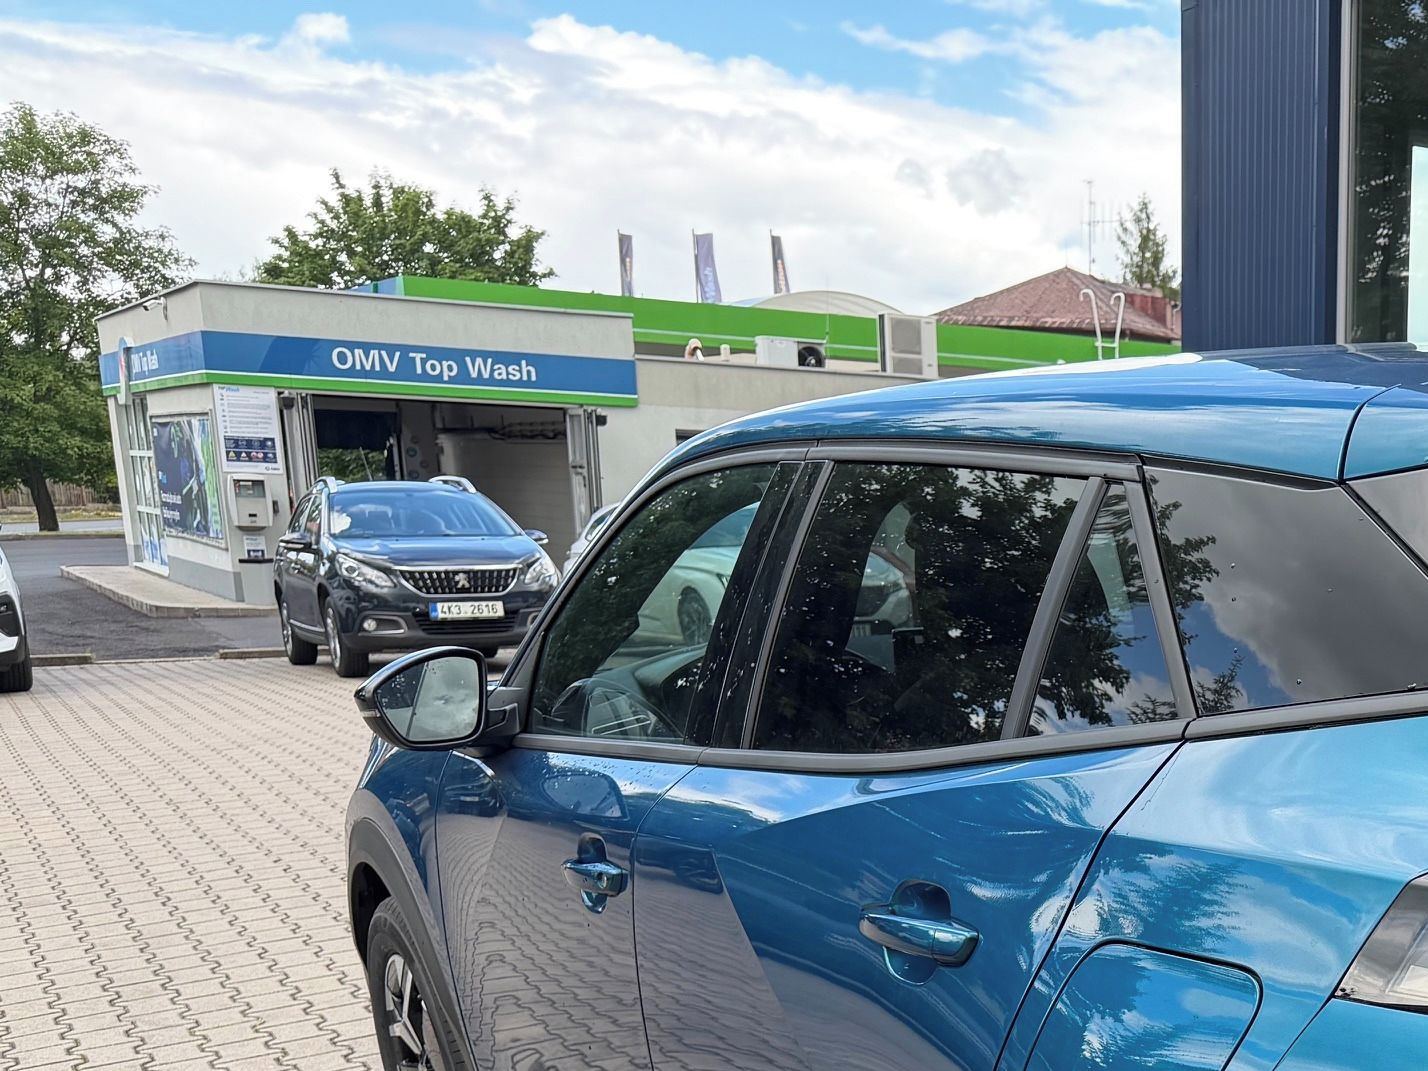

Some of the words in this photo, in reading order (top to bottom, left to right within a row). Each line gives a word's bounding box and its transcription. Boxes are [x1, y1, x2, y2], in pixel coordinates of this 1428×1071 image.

[331, 347, 401, 373] OMV
[409, 352, 458, 381] Top
[465, 356, 537, 382] Wash
[440, 604, 462, 615] 4K3
[469, 603, 498, 615] 2616
